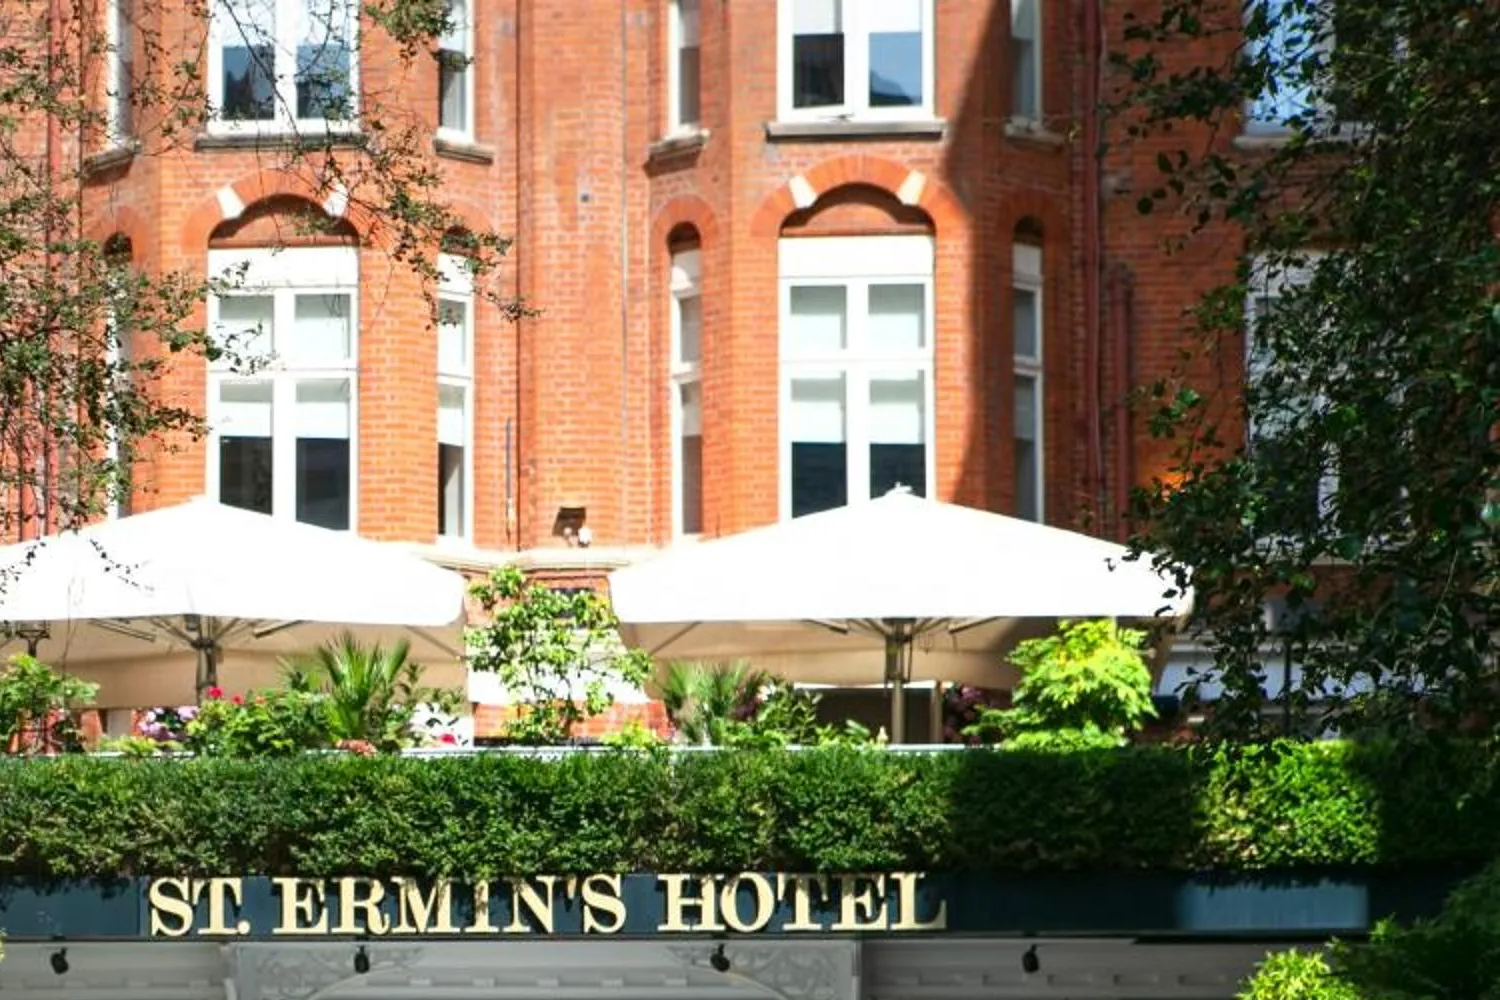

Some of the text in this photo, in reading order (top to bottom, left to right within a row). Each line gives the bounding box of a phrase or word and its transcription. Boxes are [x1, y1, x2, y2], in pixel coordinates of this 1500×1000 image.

[149, 871, 947, 936] ST. ERMIN'S HOTEL
